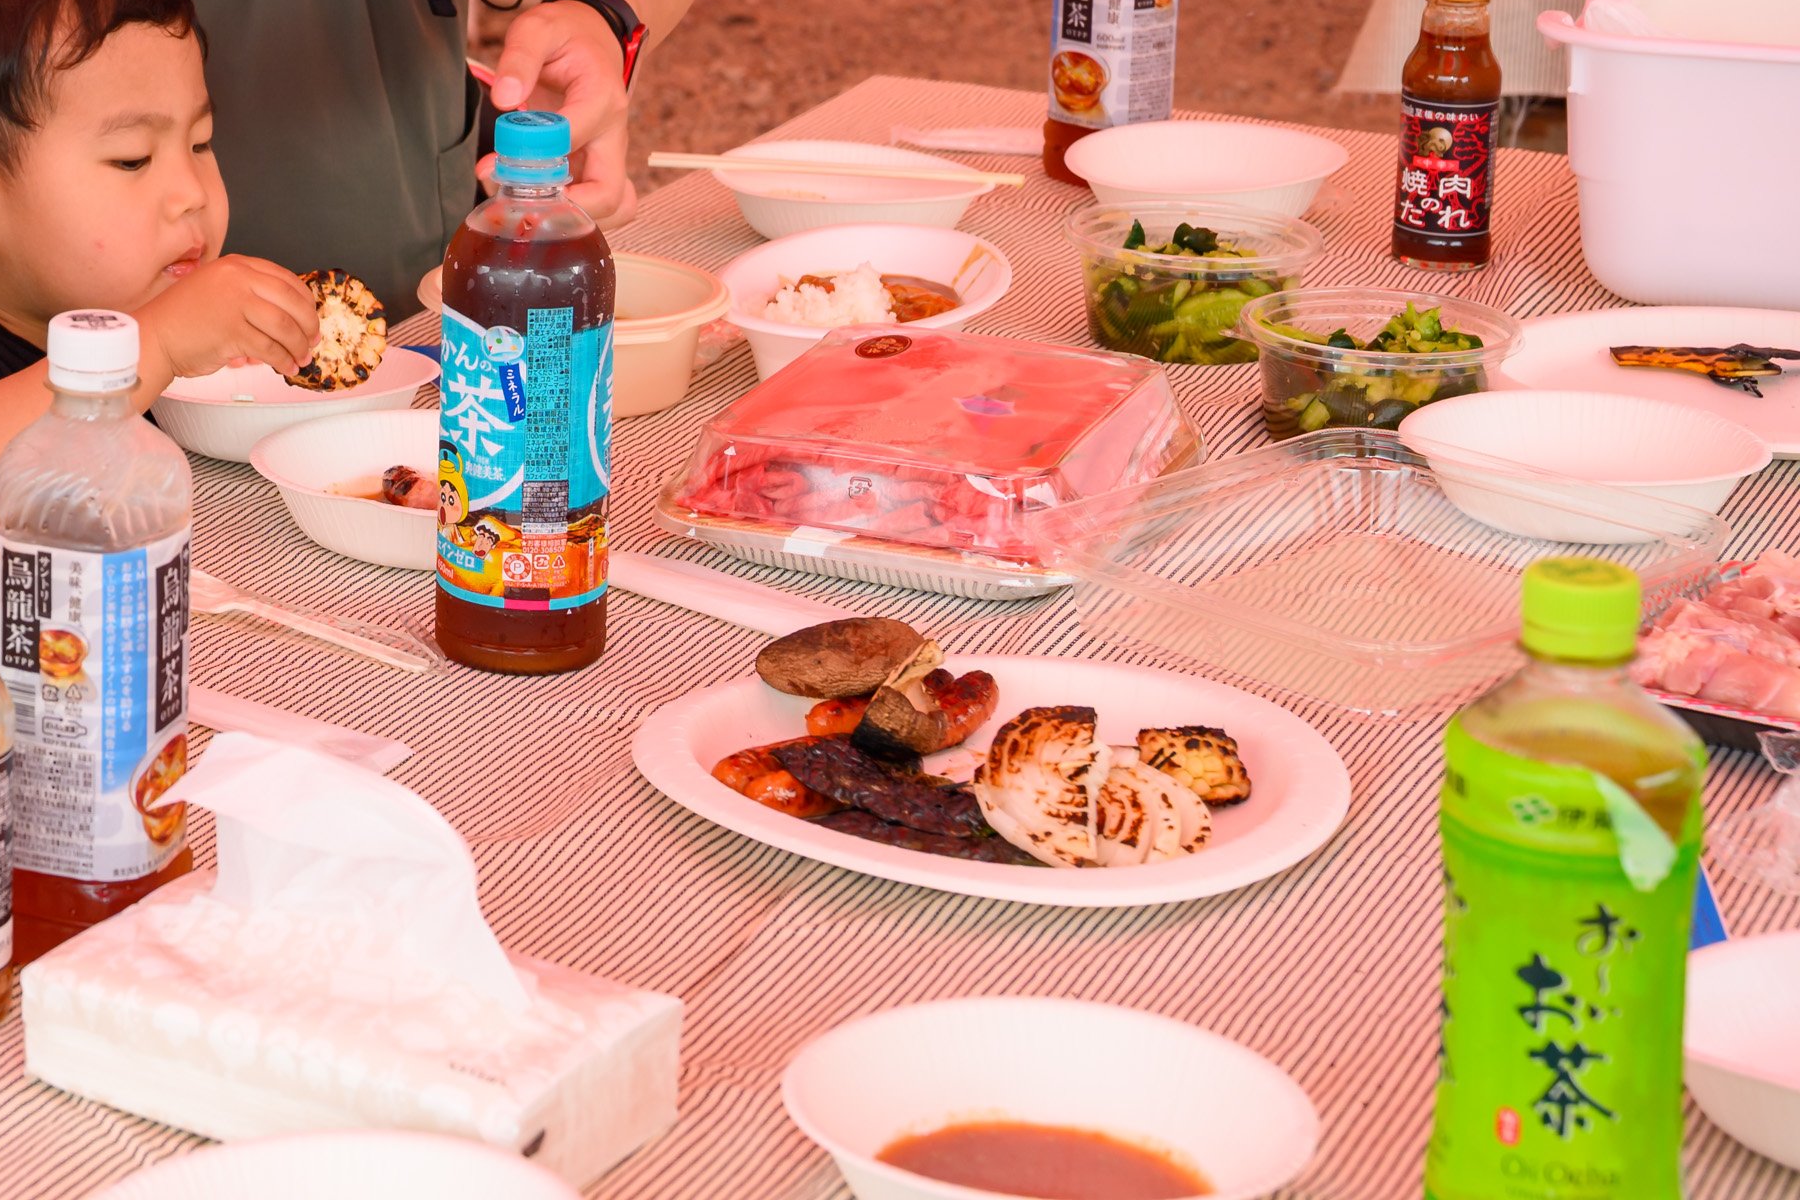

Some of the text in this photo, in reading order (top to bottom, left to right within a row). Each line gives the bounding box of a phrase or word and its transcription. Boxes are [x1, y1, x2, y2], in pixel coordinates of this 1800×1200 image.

[440, 372, 515, 458] 茶
[5, 556, 35, 656] 烏龍茶
[39, 555, 50, 614] サントリー
[161, 567, 181, 701] 烏龍茶
[4, 654, 35, 668] OTPP
[121, 562, 133, 733] おなかの脂肪を減らすのを助ける
[1513, 952, 1618, 1140] お茶
